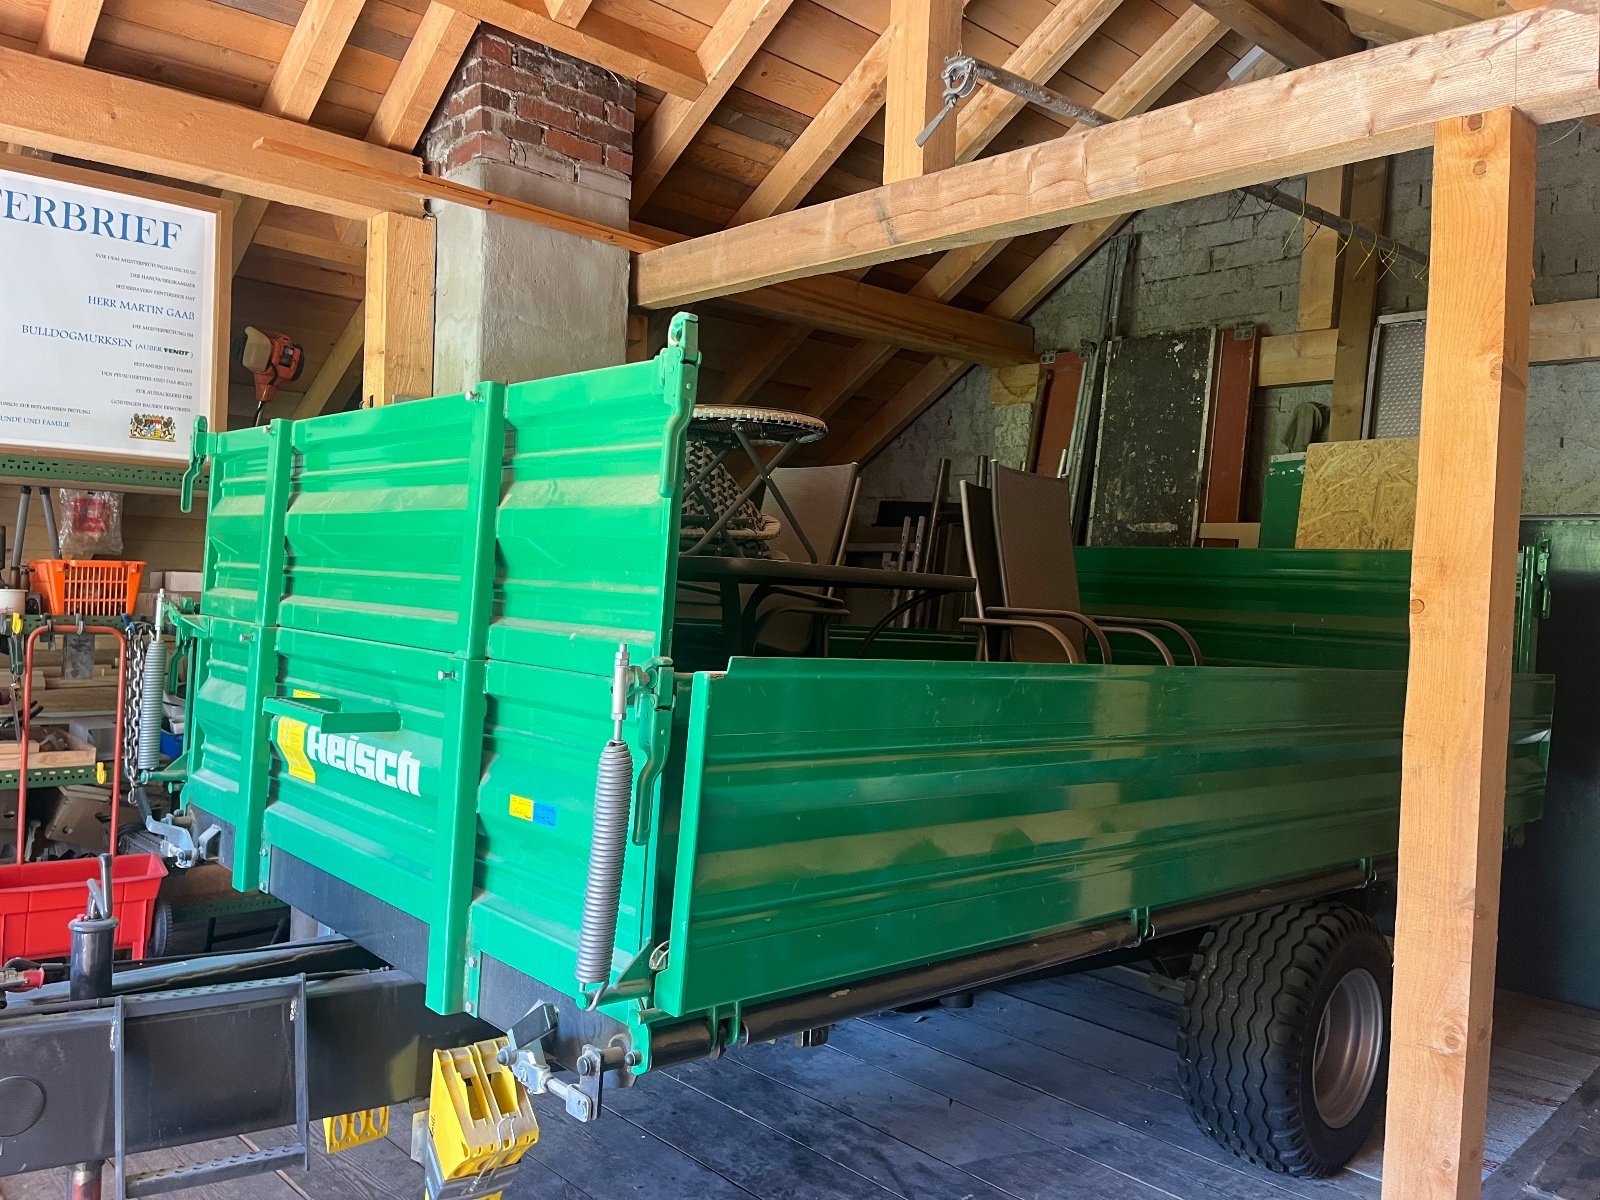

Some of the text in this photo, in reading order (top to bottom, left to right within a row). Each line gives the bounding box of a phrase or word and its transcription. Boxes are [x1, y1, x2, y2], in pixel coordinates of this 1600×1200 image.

[0, 189, 182, 249] ERBRIEF
[141, 273, 196, 288] HANDWERKSKAMMER
[185, 294, 195, 302] HAT
[88, 295, 117, 308] HERR
[120, 300, 163, 315] MARTIN
[142, 325, 186, 337] MEISTERPRÜFUNG
[22, 324, 133, 348] BULLDOGMURKSEN
[163, 346, 190, 356] FENDT
[133, 361, 163, 370] BESTANDEN
[113, 372, 152, 382] PFUSCHERTITEL
[30, 404, 67, 412] BESTANDENEN
[67, 407, 91, 415] PRÜFUNG
[142, 402, 163, 410] BAUERN
[23, 417, 41, 425] UND
[42, 420, 72, 428] FAMILIE
